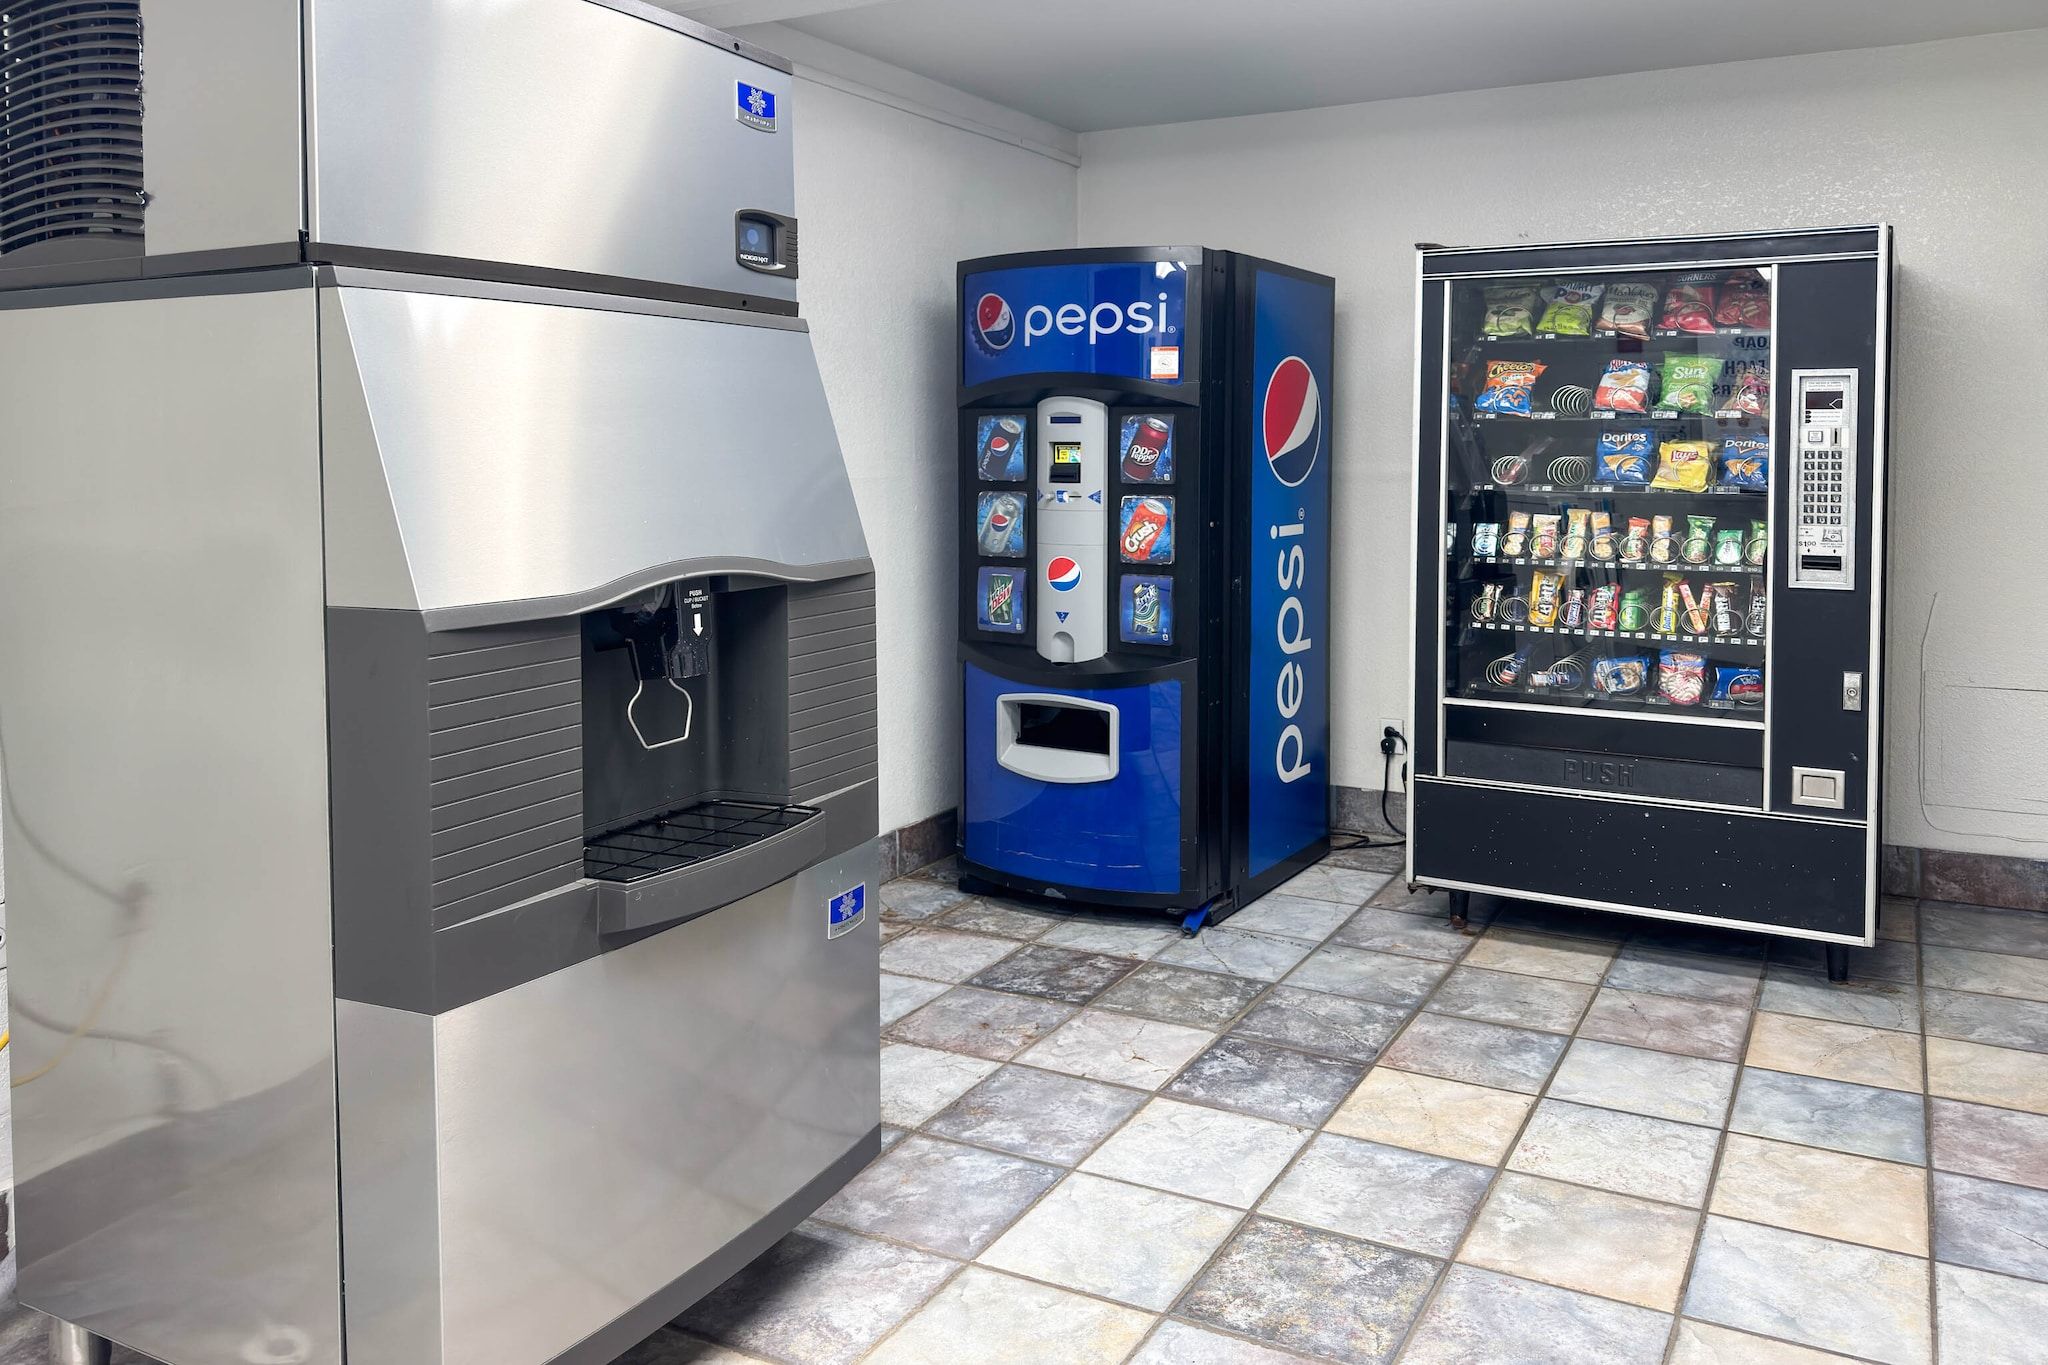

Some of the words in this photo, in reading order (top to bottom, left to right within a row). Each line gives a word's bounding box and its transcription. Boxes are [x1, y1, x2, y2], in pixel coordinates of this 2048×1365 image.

[1024, 292, 1168, 347] pepsi
[1602, 432, 1647, 442] Doritos
[1125, 520, 1159, 553] Crush
[1270, 523, 1311, 784] pepsi
[1563, 759, 1635, 787] PUSH
